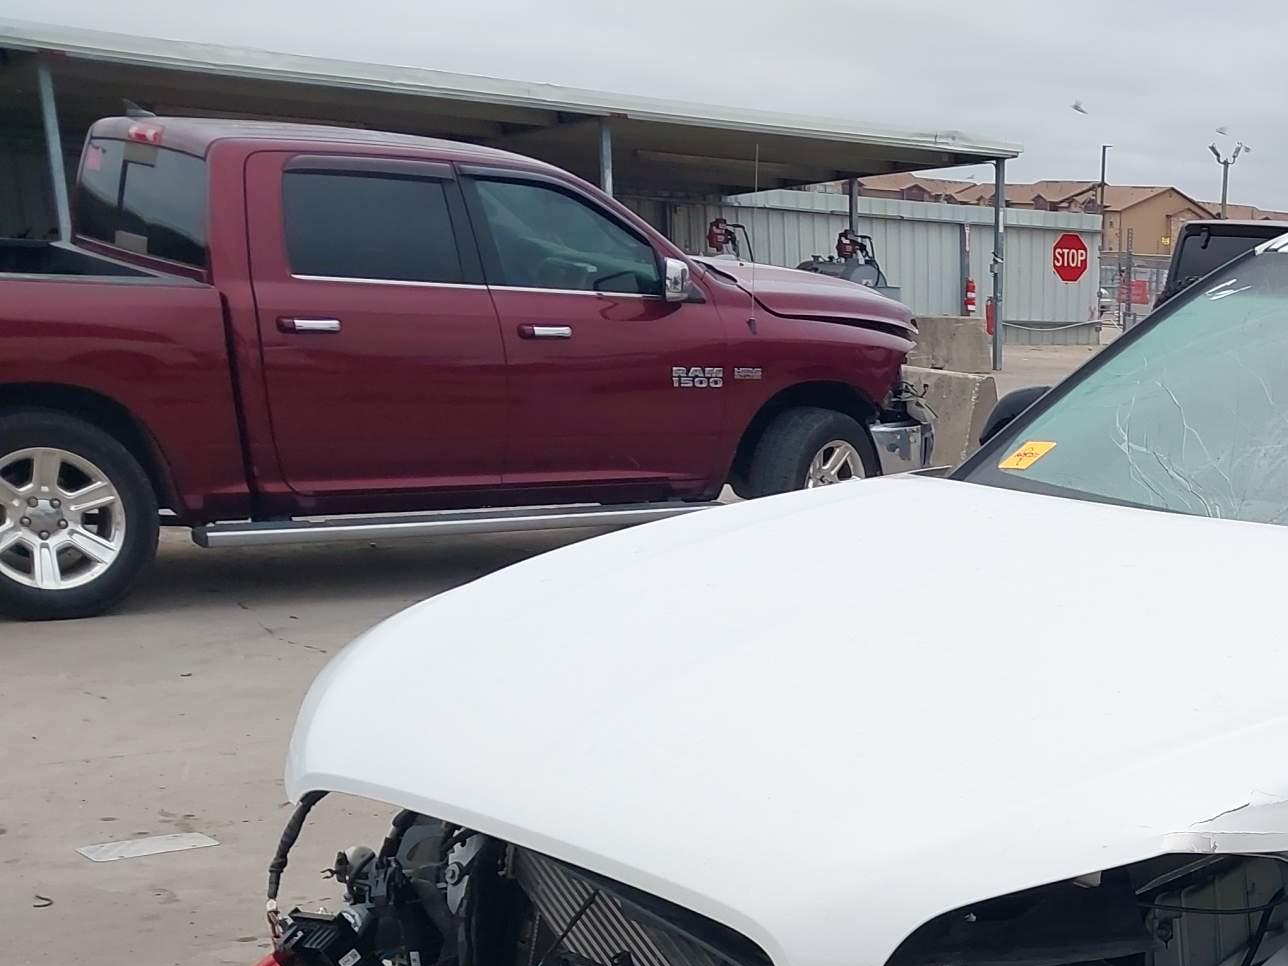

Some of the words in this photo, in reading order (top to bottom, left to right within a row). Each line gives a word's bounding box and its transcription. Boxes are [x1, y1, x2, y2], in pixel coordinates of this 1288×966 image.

[1055, 248, 1086, 267] STOP
[672, 367, 723, 377] RAM
[672, 378, 723, 388] 1500
